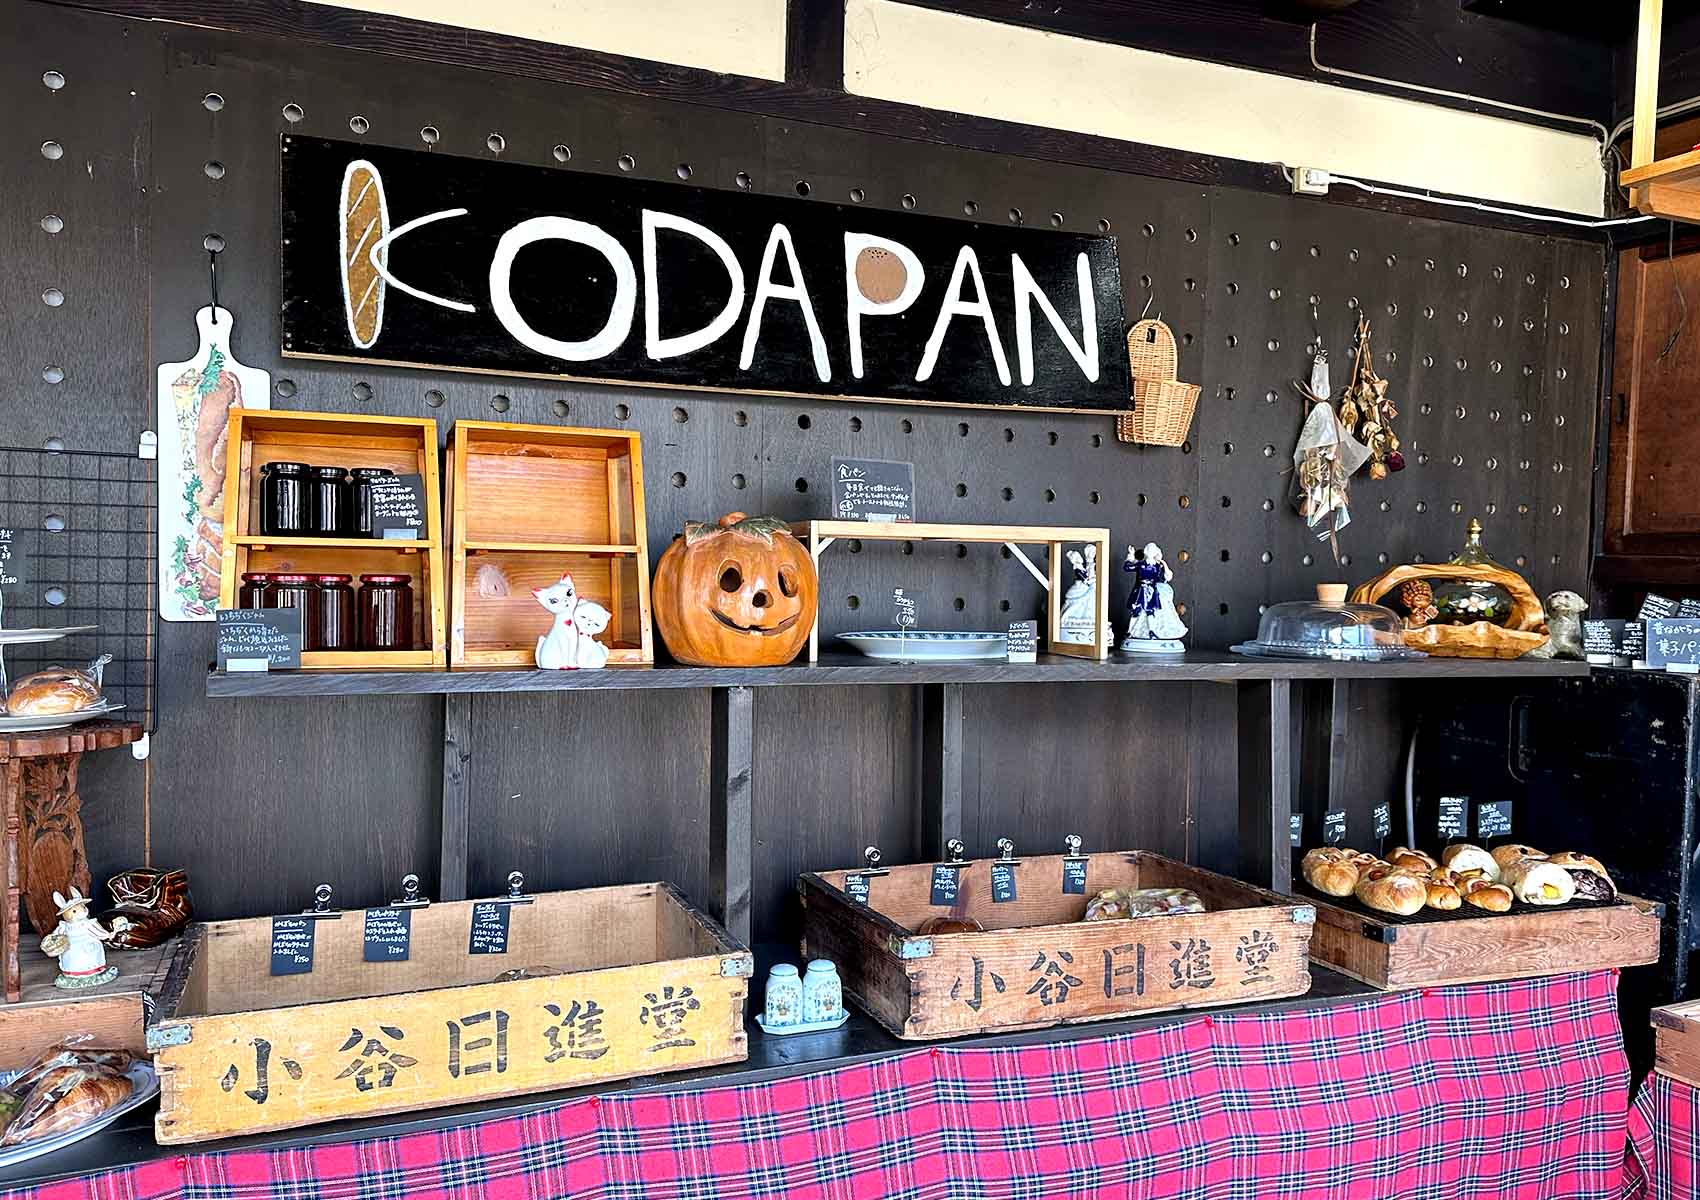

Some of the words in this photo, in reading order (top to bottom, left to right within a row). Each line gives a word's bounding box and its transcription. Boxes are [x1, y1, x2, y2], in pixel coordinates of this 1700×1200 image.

[340, 159, 1099, 385] KODAPAN
[838, 464, 866, 479] 食パン
[950, 929, 1280, 1013] 小谷日進堂
[220, 985, 702, 1105] 小谷日進堂
